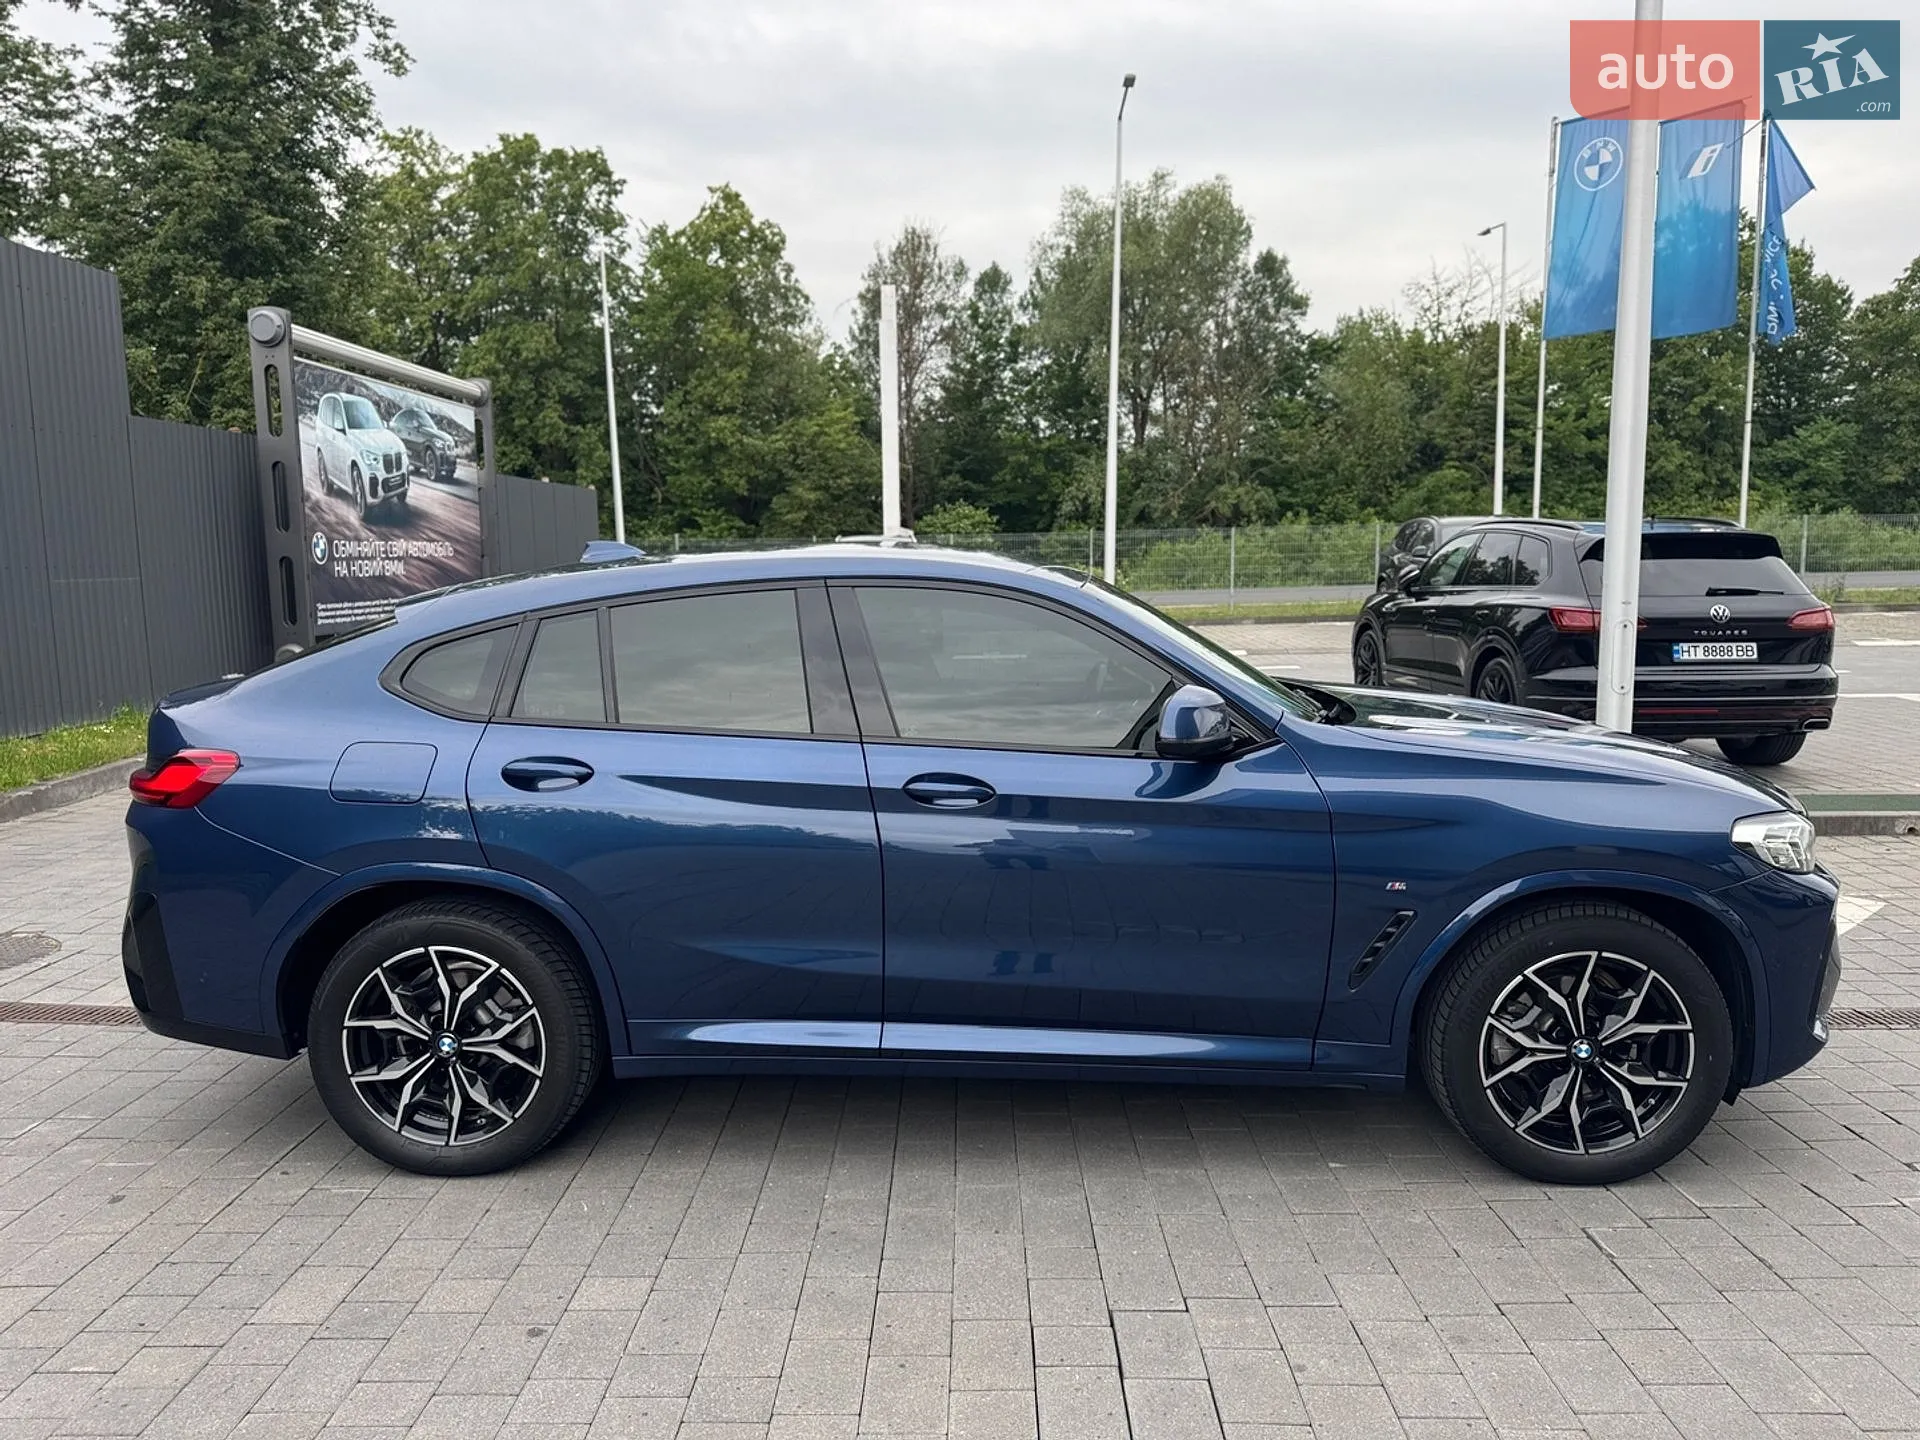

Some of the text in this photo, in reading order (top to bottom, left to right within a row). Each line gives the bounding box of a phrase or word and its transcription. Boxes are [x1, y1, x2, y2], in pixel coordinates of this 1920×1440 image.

[334, 560, 349, 577] НА
[350, 558, 383, 577] НОВИЙ
[1681, 645, 1700, 657] HT
[1702, 645, 1734, 657] 8888
[1735, 645, 1755, 657] BB
